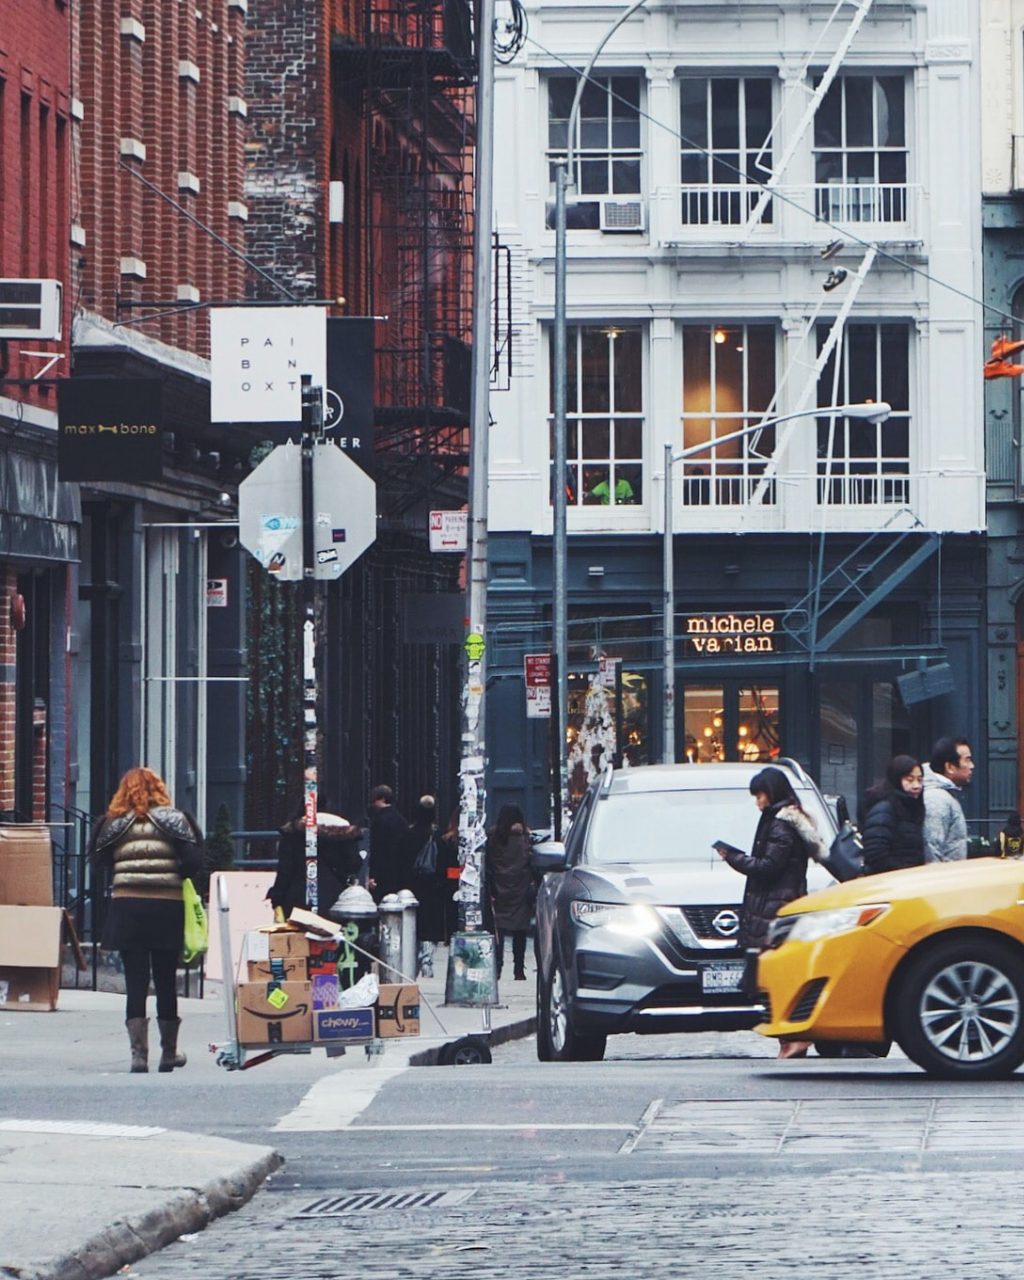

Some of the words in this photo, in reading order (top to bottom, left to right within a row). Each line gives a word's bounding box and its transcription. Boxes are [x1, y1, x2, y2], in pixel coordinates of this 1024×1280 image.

[65, 424, 97, 435] max
[120, 422, 157, 435] bone
[686, 614, 775, 634] michele
[691, 635, 774, 652] varian
